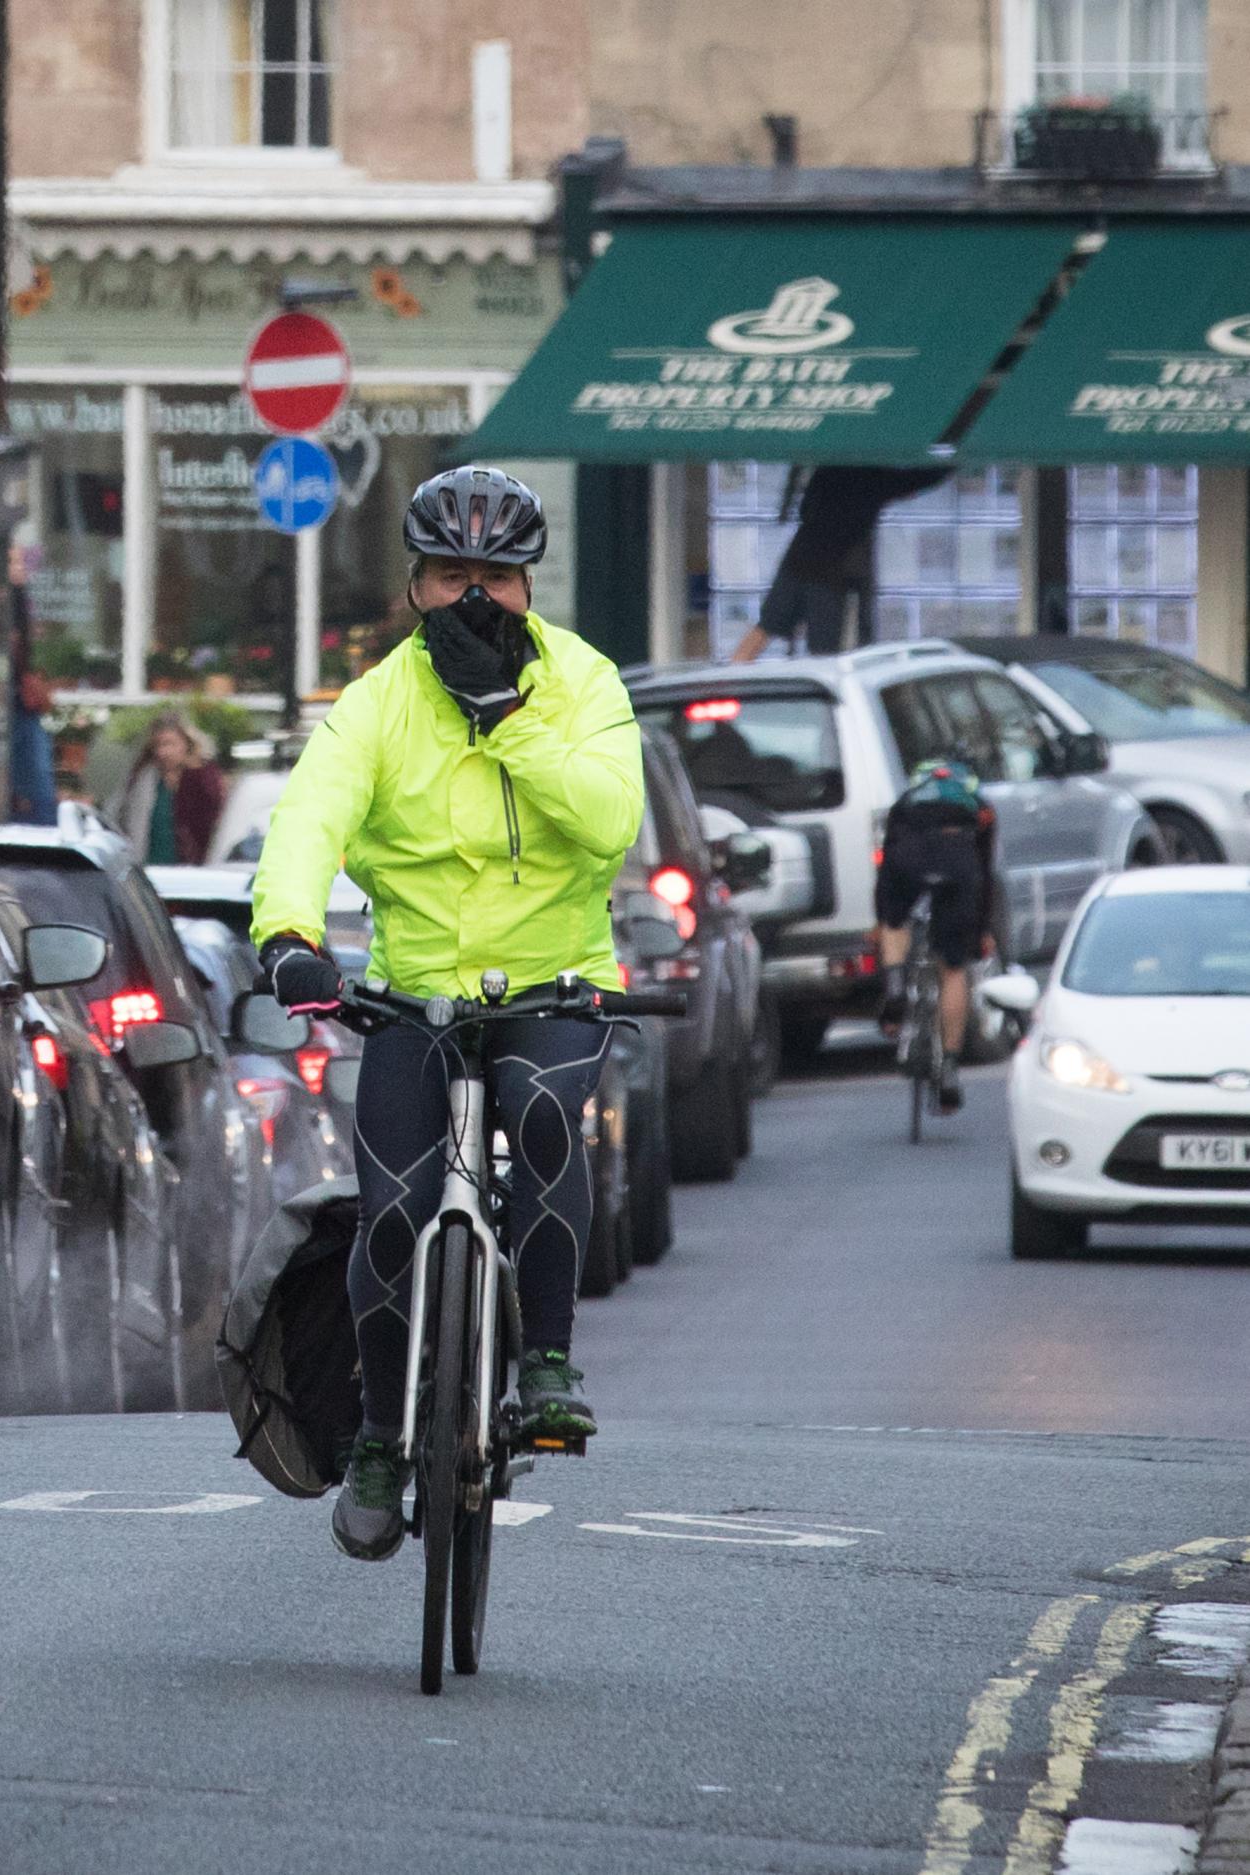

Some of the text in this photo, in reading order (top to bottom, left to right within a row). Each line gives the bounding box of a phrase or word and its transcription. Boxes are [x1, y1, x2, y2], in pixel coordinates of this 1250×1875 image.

[659, 359, 852, 382] THE BATH
[572, 382, 895, 410] PROPERTY SHOP
